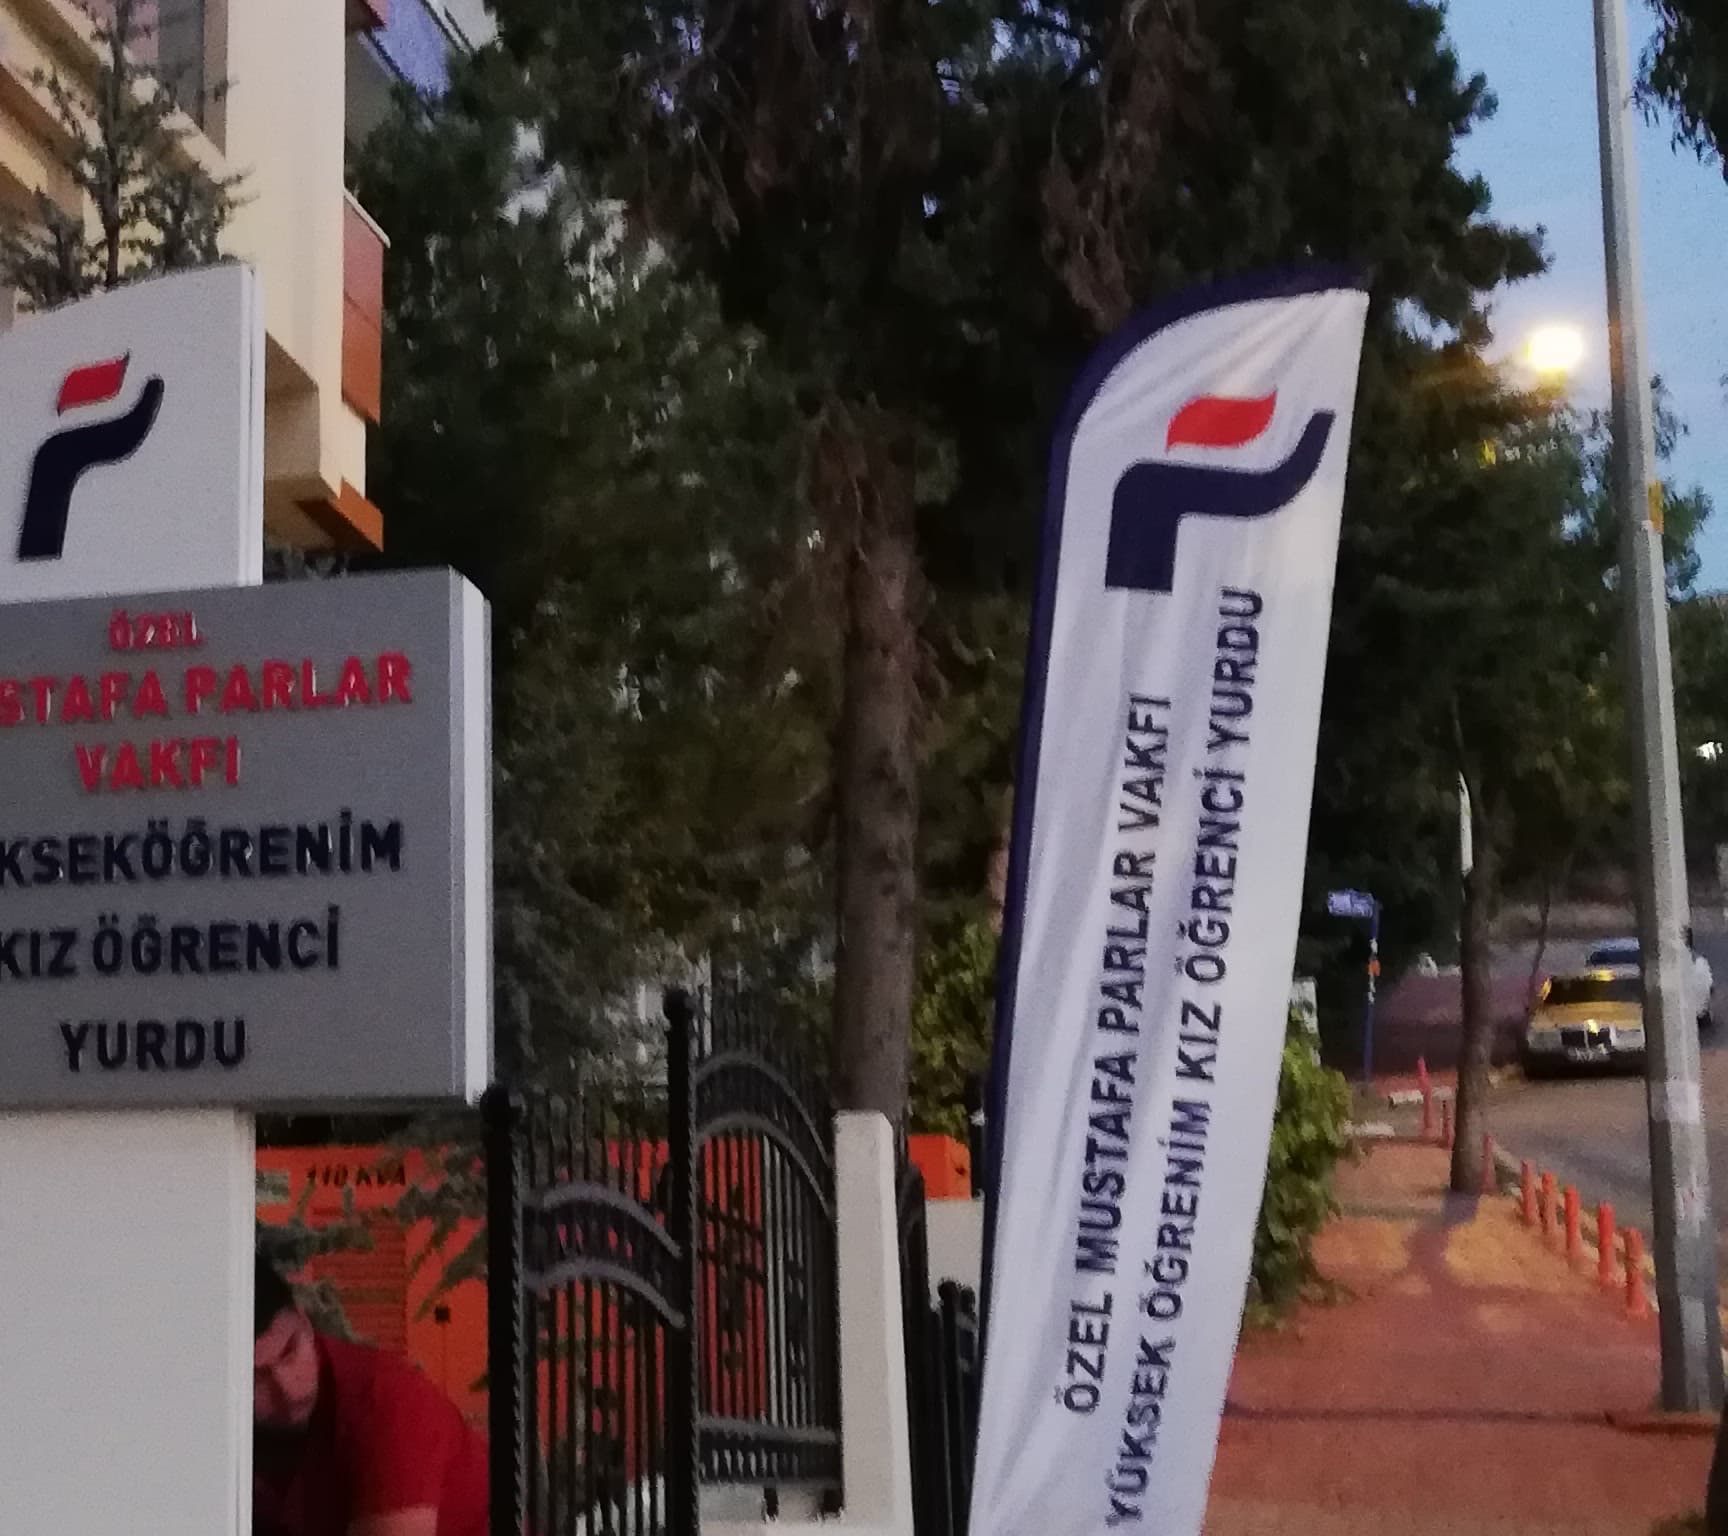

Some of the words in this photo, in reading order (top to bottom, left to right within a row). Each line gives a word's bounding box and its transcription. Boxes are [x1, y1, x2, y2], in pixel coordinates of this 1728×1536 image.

[184, 652, 412, 715] PARLAR
[1207, 586, 1262, 754] YURDU
[76, 735, 240, 792] VAKFI
[1118, 693, 1171, 834] VAKFI
[91, 904, 339, 976] ÖĞRENCİ
[1097, 850, 1155, 1036] PARLAR
[1176, 767, 1246, 984] ÖĞRENCİ
[60, 1018, 246, 1072] YURDU
[1175, 1001, 1221, 1083] KIZ
[1075, 1050, 1138, 1275] MUSTAFA
[1140, 1099, 1211, 1322] ÖĞRENİM
[1054, 1291, 1114, 1415] ÖZEL
[1105, 1335, 1176, 1528] YÜKSEK
